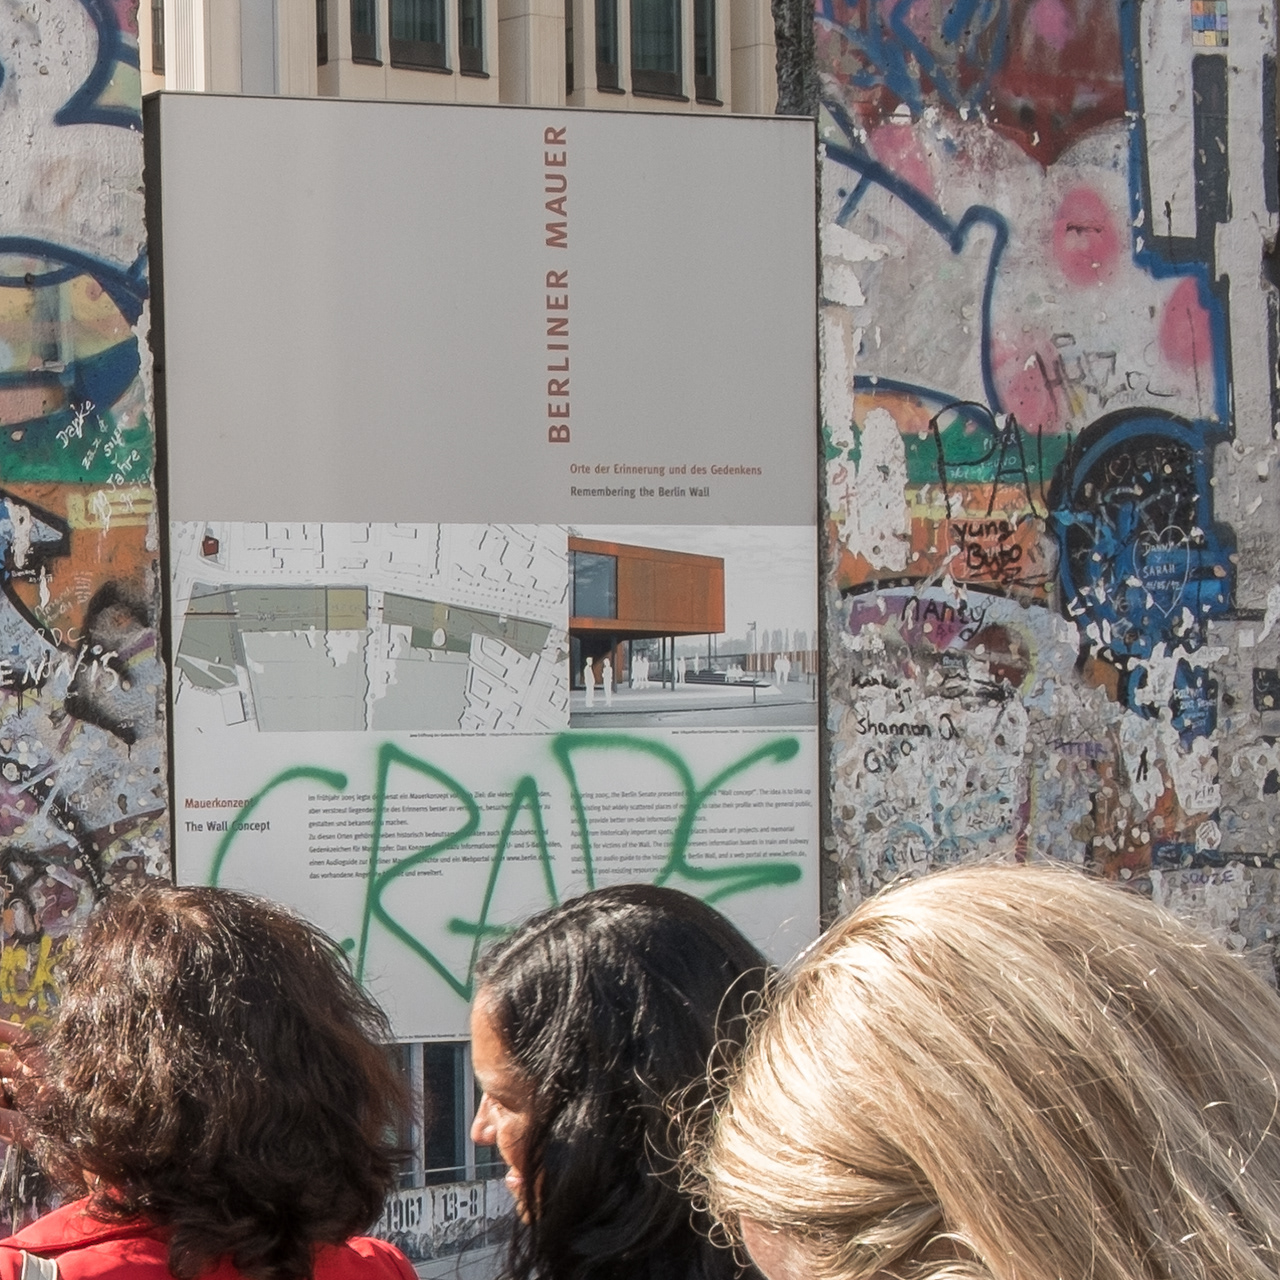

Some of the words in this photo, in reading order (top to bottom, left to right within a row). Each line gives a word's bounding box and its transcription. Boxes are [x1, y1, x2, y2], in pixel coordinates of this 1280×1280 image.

[544, 127, 567, 248] MAUER
[546, 269, 569, 443] BERLINER
[570, 464, 590, 474] Orte
[595, 464, 612, 474] der
[613, 464, 665, 477] Erinnerung
[669, 464, 686, 474] und
[691, 464, 707, 474] des
[711, 464, 762, 475] Gedenkens
[571, 486, 636, 499] Remembering
[639, 486, 655, 497] the
[658, 487, 686, 497] Berlin
[689, 487, 710, 497] Wall
[184, 820, 202, 832] The
[204, 820, 225, 832] Wall
[228, 820, 270, 835] Concept
